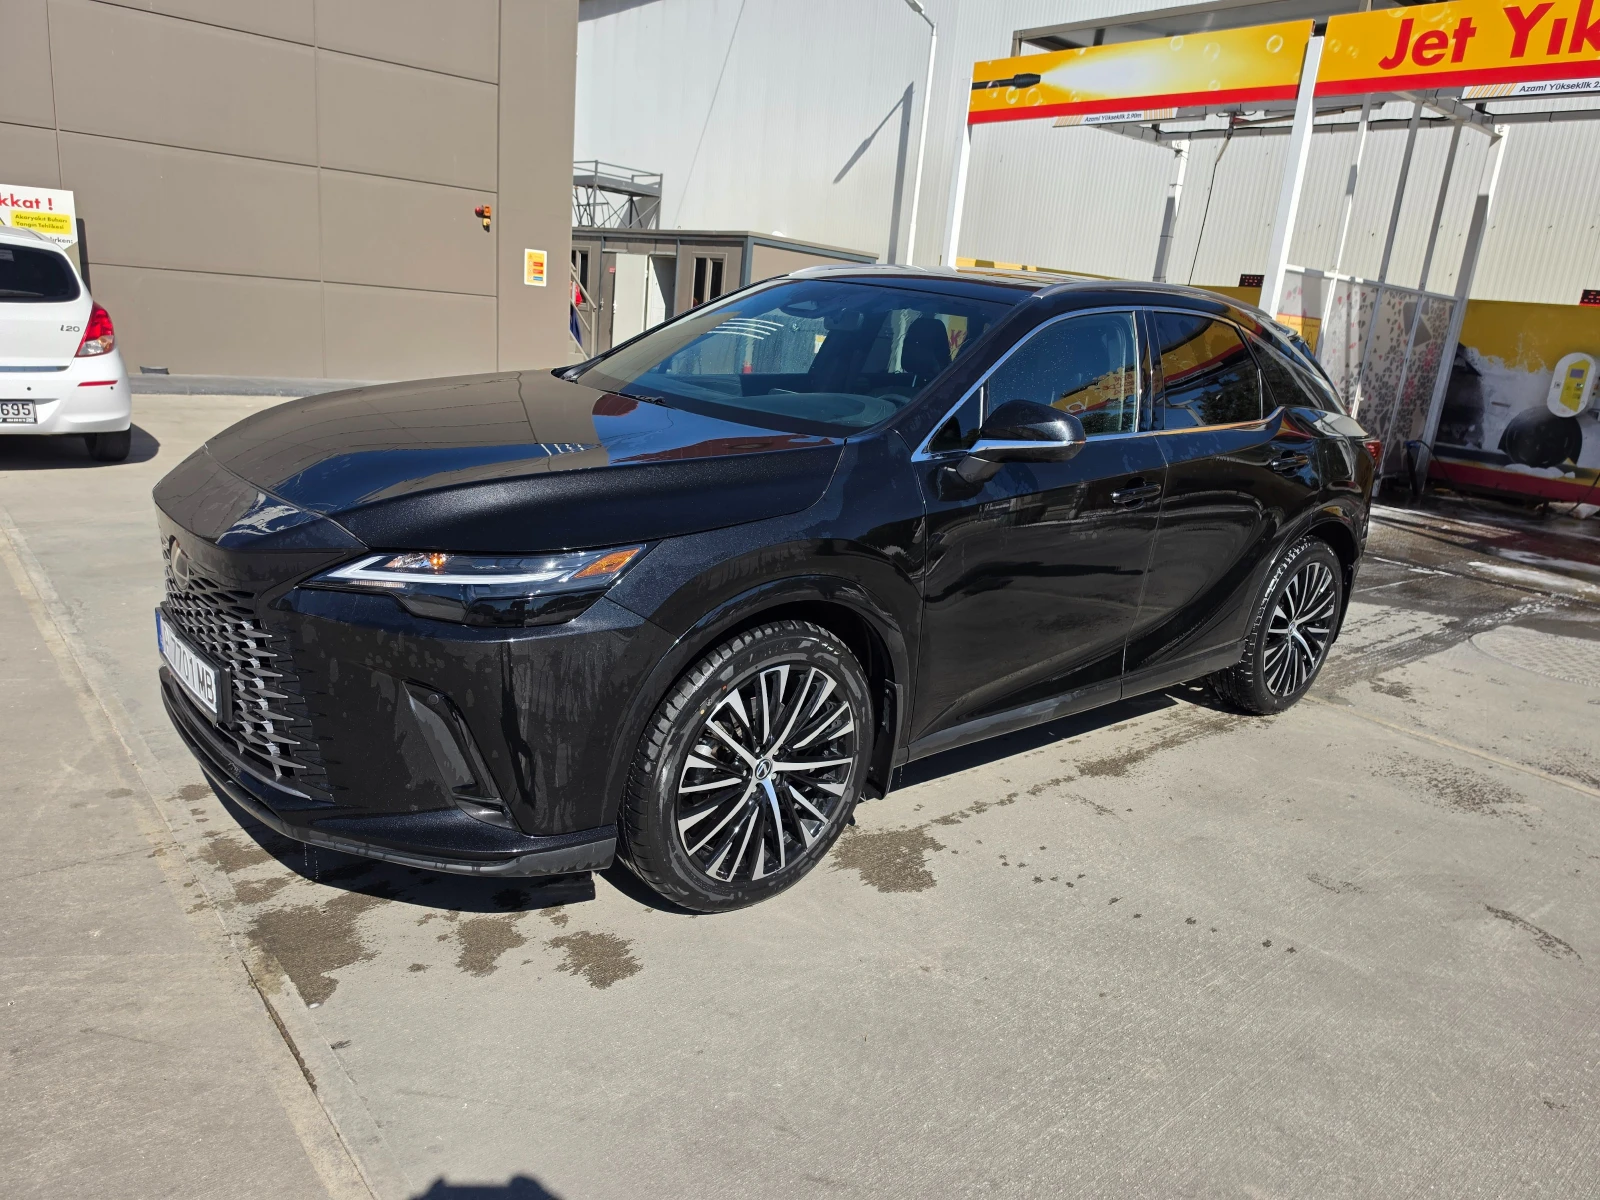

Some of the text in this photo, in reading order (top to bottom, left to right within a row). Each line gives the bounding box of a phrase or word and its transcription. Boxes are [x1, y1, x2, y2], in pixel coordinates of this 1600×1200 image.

[1378, 0, 1600, 70] Jet Yık
[1549, 81, 1592, 91] Yükseklik
[48, 197, 53, 211] !
[0, 402, 31, 416] 695
